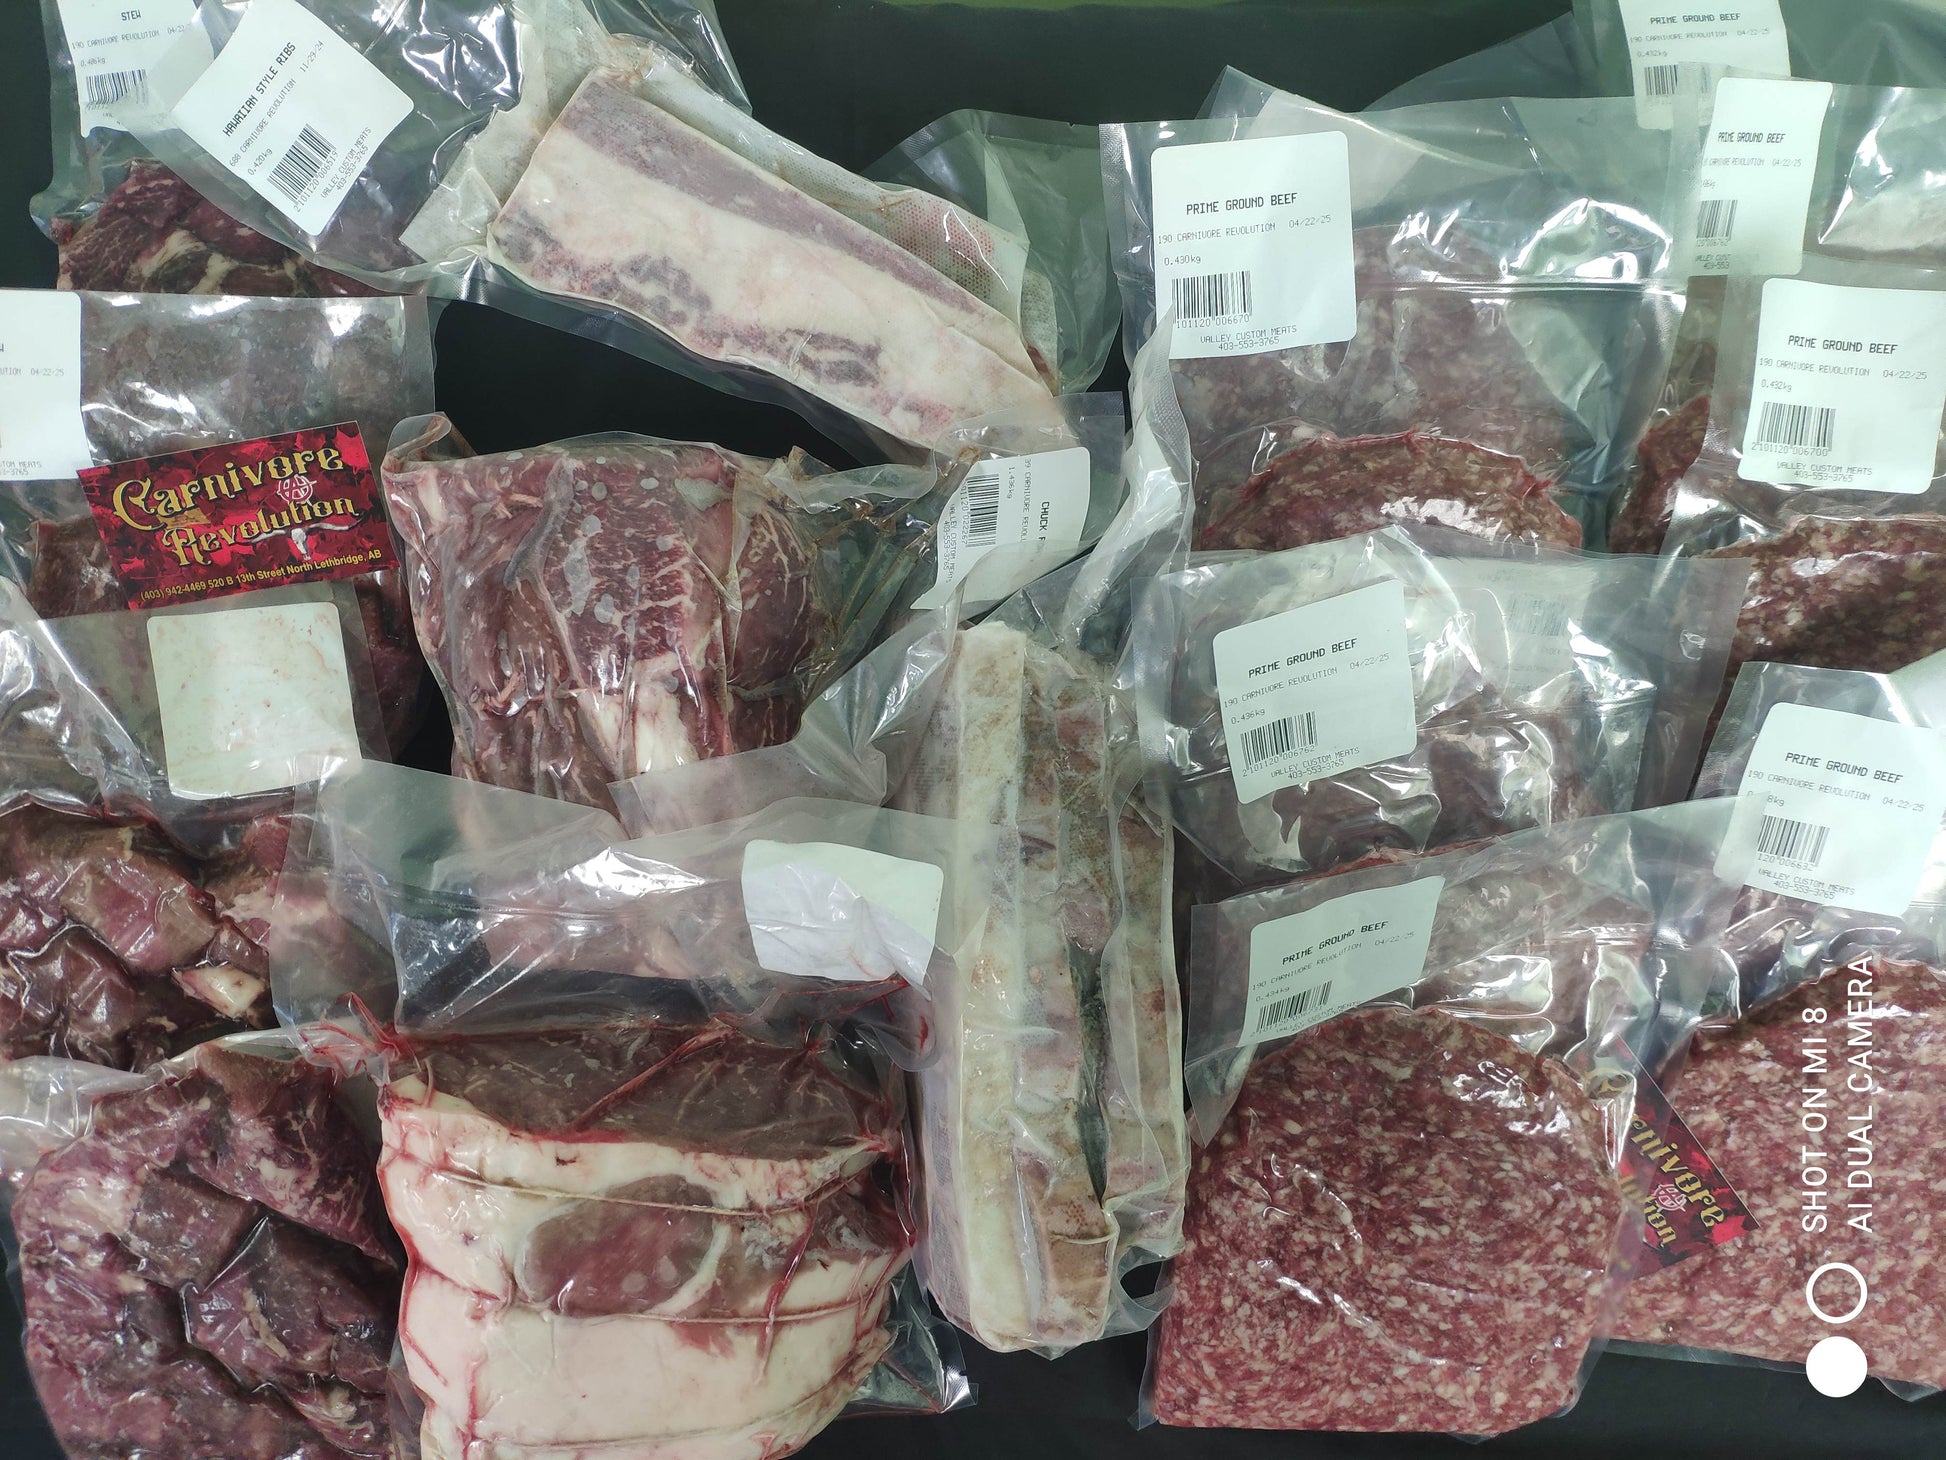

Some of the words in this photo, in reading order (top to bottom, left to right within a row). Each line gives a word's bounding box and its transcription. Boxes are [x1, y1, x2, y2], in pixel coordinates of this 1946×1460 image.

[121, 10, 141, 21] STEW
[1650, 15, 1678, 25] PRIME
[1683, 14, 1715, 23] GROUND
[1720, 13, 1741, 21] BEEF
[223, 95, 258, 137] HAWAIIAN
[256, 66, 278, 95] STYLE
[276, 42, 296, 66] RIBS
[240, 119, 268, 153] CARNIVORE
[267, 79, 296, 118] REVOLUTION
[300, 40, 324, 73] 11/29/24
[1718, 132, 1735, 143] PRIME
[1737, 132, 1763, 143] GROUND
[1767, 133, 1786, 143] BEEF
[247, 149, 273, 176] 0.420kg
[321, 175, 340, 198] VALLEY
[338, 148, 355, 174] CUSTOM
[354, 127, 371, 147] MEATS
[337, 145, 369, 191] 403-553-3765
[1186, 202, 1219, 215] PRIME
[1226, 197, 1264, 211] GROUND
[1270, 192, 1298, 206] BEEF
[1158, 234, 1172, 245] 190
[1177, 229, 1221, 242] CARNIVORE
[1226, 222, 1275, 236] REVOLUTION
[1289, 214, 1331, 229] 04/22/25
[1164, 255, 1201, 266] 0.430kg
[1201, 333, 1231, 344] VALLEY
[1236, 329, 1267, 340] CUSTOM
[1271, 325, 1297, 336] MEATS
[1218, 337, 1280, 351] 403-553-3765
[1788, 335, 1816, 349] PRIME
[1823, 340, 1862, 353] GROUND
[1869, 343, 1898, 355] BEEF
[1760, 358, 1772, 367] 190
[1776, 360, 1814, 372] CARNIVORE
[1819, 365, 1870, 376] REVOLUTION
[1883, 370, 1928, 380] 04/22/25
[1811, 464, 1842, 473] CUSTOM
[1847, 466, 1872, 476] MEATS
[112, 447, 344, 531] Carnivore
[1040, 501, 1050, 531] CHUCK
[162, 497, 360, 567] Revolution
[140, 588, 164, 602] (403)
[165, 580, 207, 598] 942-4469
[208, 577, 225, 590] 520
[226, 575, 234, 585] B
[235, 572, 256, 585] 13th
[257, 566, 286, 582] Street
[286, 561, 314, 575] North
[314, 553, 368, 572] Lethbridge,
[368, 549, 382, 560] AB
[1249, 661, 1280, 678] PRIME
[1287, 647, 1326, 667] GROUND
[1332, 637, 1358, 654] BEEF
[1224, 697, 1238, 708] 190
[1242, 681, 1284, 703] CARNIVORE
[1288, 666, 1338, 687] REVOLUTION
[1350, 652, 1390, 670] 04/22/25
[1231, 708, 1266, 725] 0.436kg
[1288, 760, 1345, 780] 403-553-3765
[1302, 754, 1332, 770] CUSTOM
[1335, 747, 1360, 761] MEATS
[1785, 752, 1821, 768] PRIME
[1826, 760, 1868, 777] GROUND
[1874, 771, 1903, 784] BEEF
[1748, 769, 1763, 780] 190
[1768, 773, 1815, 791] CARNIVORE
[1819, 783, 1870, 801] REVOLUTION
[1882, 797, 1924, 812] 04/22/25
[1774, 881, 1836, 899] 403-553-3765
[1794, 876, 1824, 888] CUSTOM
[1828, 884, 1855, 895] MEATS
[1282, 946, 1314, 966] PRIME
[1319, 929, 1354, 950] GROUND
[1361, 921, 1389, 933] BEEF
[1253, 980, 1266, 991] 190
[1270, 963, 1313, 984] CARNIVORE
[1316, 942, 1362, 966] REVOLUTION
[1374, 931, 1415, 946] 04/22/25
